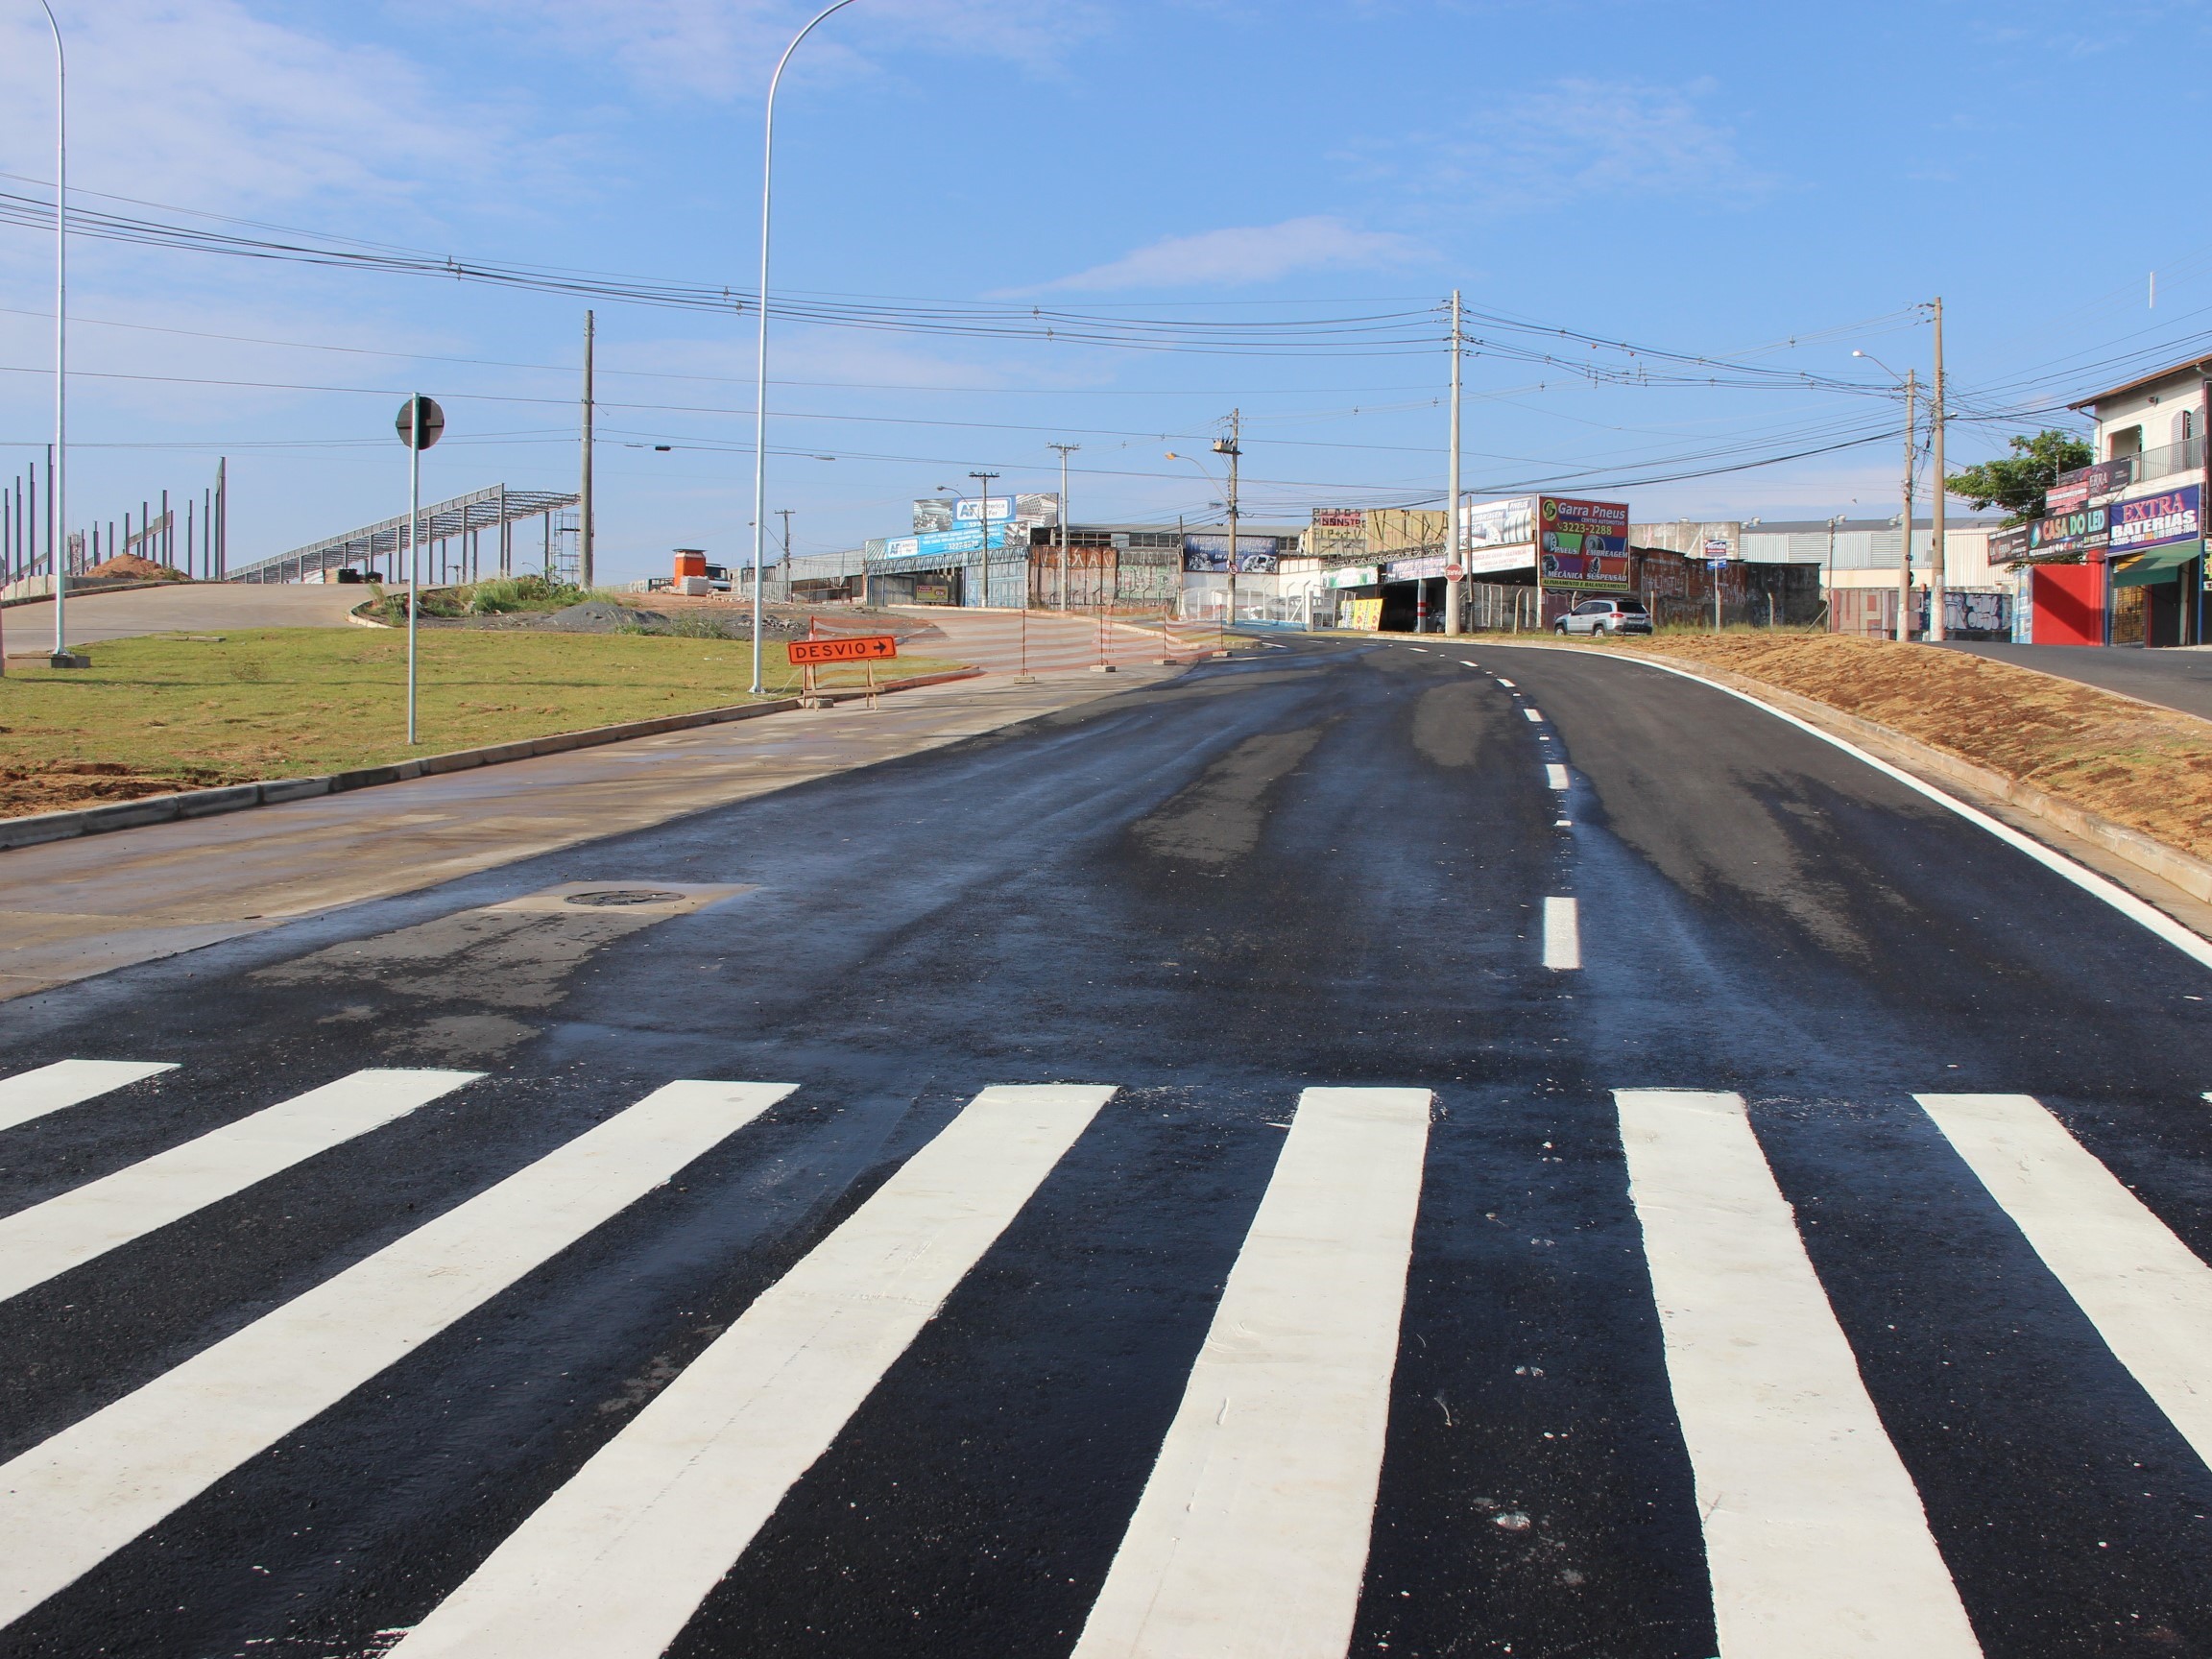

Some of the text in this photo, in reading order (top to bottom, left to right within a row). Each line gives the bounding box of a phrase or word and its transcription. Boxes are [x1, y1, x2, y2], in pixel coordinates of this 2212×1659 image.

[1558, 502, 1625, 519] Garra Pneus
[2122, 493, 2185, 523] EXTRA
[1562, 521, 1612, 536] 3223-2288
[2042, 518, 2067, 541] CASA
[2070, 513, 2085, 536] DO
[2087, 510, 2104, 533] LED
[2111, 510, 2197, 540] BATERIAS
[1586, 549, 1628, 559] EMBREAGEM
[1548, 569, 1627, 582] MECÂNICA SUSPENSÃO
[795, 642, 866, 659] DESVIO
